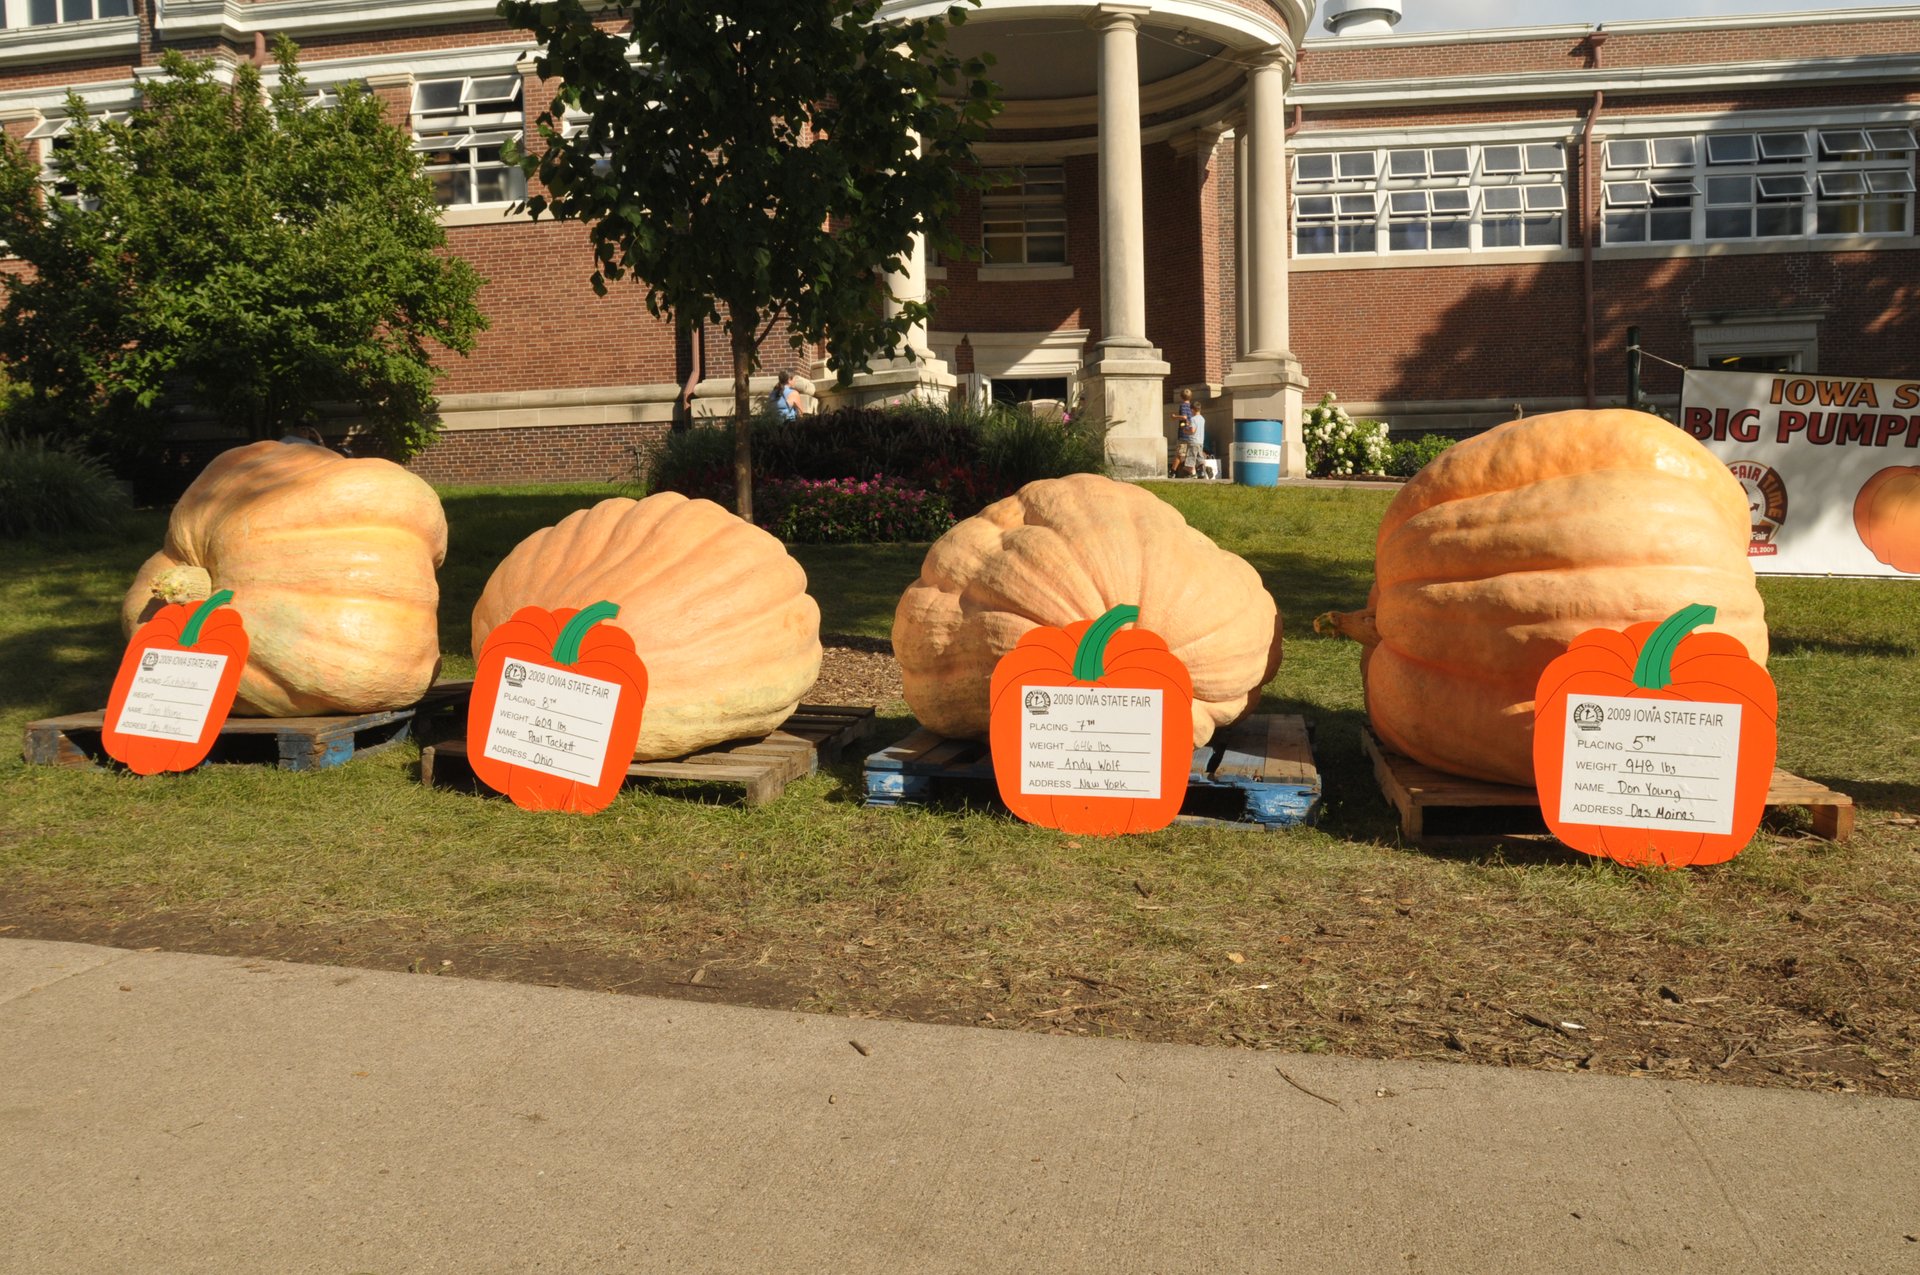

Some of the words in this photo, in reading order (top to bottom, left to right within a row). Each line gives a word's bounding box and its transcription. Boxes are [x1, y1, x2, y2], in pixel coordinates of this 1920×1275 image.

[1770, 378, 1879, 408] IOWA
[1893, 384, 1920, 409] S
[1684, 407, 1760, 442] BIG
[1247, 448, 1278, 457] ARTISTIC
[1730, 465, 1762, 482] FAIR
[1762, 474, 1783, 518] TIME
[1751, 532, 1768, 541] Fair
[159, 655, 173, 665] 2009
[173, 656, 187, 666] IOWA
[186, 657, 206, 668] STATE
[206, 659, 219, 669] FAIR
[528, 670, 546, 683] 2009
[546, 674, 567, 688] IOWA
[568, 679, 591, 695] STATE
[592, 685, 609, 699] FAIR
[504, 692, 536, 707] PLACING
[1053, 693, 1074, 706] 2009
[1076, 694, 1100, 706] IOWA
[1101, 695, 1128, 706] STATE
[1130, 696, 1151, 708] FAIR
[500, 710, 529, 723] WEIGHT
[535, 716, 552, 730] 609
[557, 720, 567, 732] lbs
[1607, 708, 1631, 721] 2009
[1634, 709, 1661, 723] IOWA
[1664, 712, 1696, 725] STATE
[1699, 713, 1723, 727] FAIR
[496, 727, 517, 739] NAME
[528, 730, 543, 743] Paul
[1029, 723, 1068, 732] PLACING
[1029, 742, 1064, 750] WEIGHT
[1098, 741, 1112, 752] lbs
[1577, 739, 1623, 751] PLACING
[492, 744, 527, 760] ADDRESS
[533, 753, 554, 767] Ohio
[1064, 758, 1092, 773] Andy
[1098, 760, 1121, 771] Wolf
[1576, 761, 1618, 772] WEIGHT
[1626, 759, 1654, 772] 948
[1661, 762, 1676, 774] lbs
[1029, 780, 1071, 788] ADDRESS
[1574, 782, 1605, 792] NAME
[1618, 781, 1640, 794] Don
[1645, 782, 1681, 803] Young
[1573, 803, 1623, 815] ADDRESS
